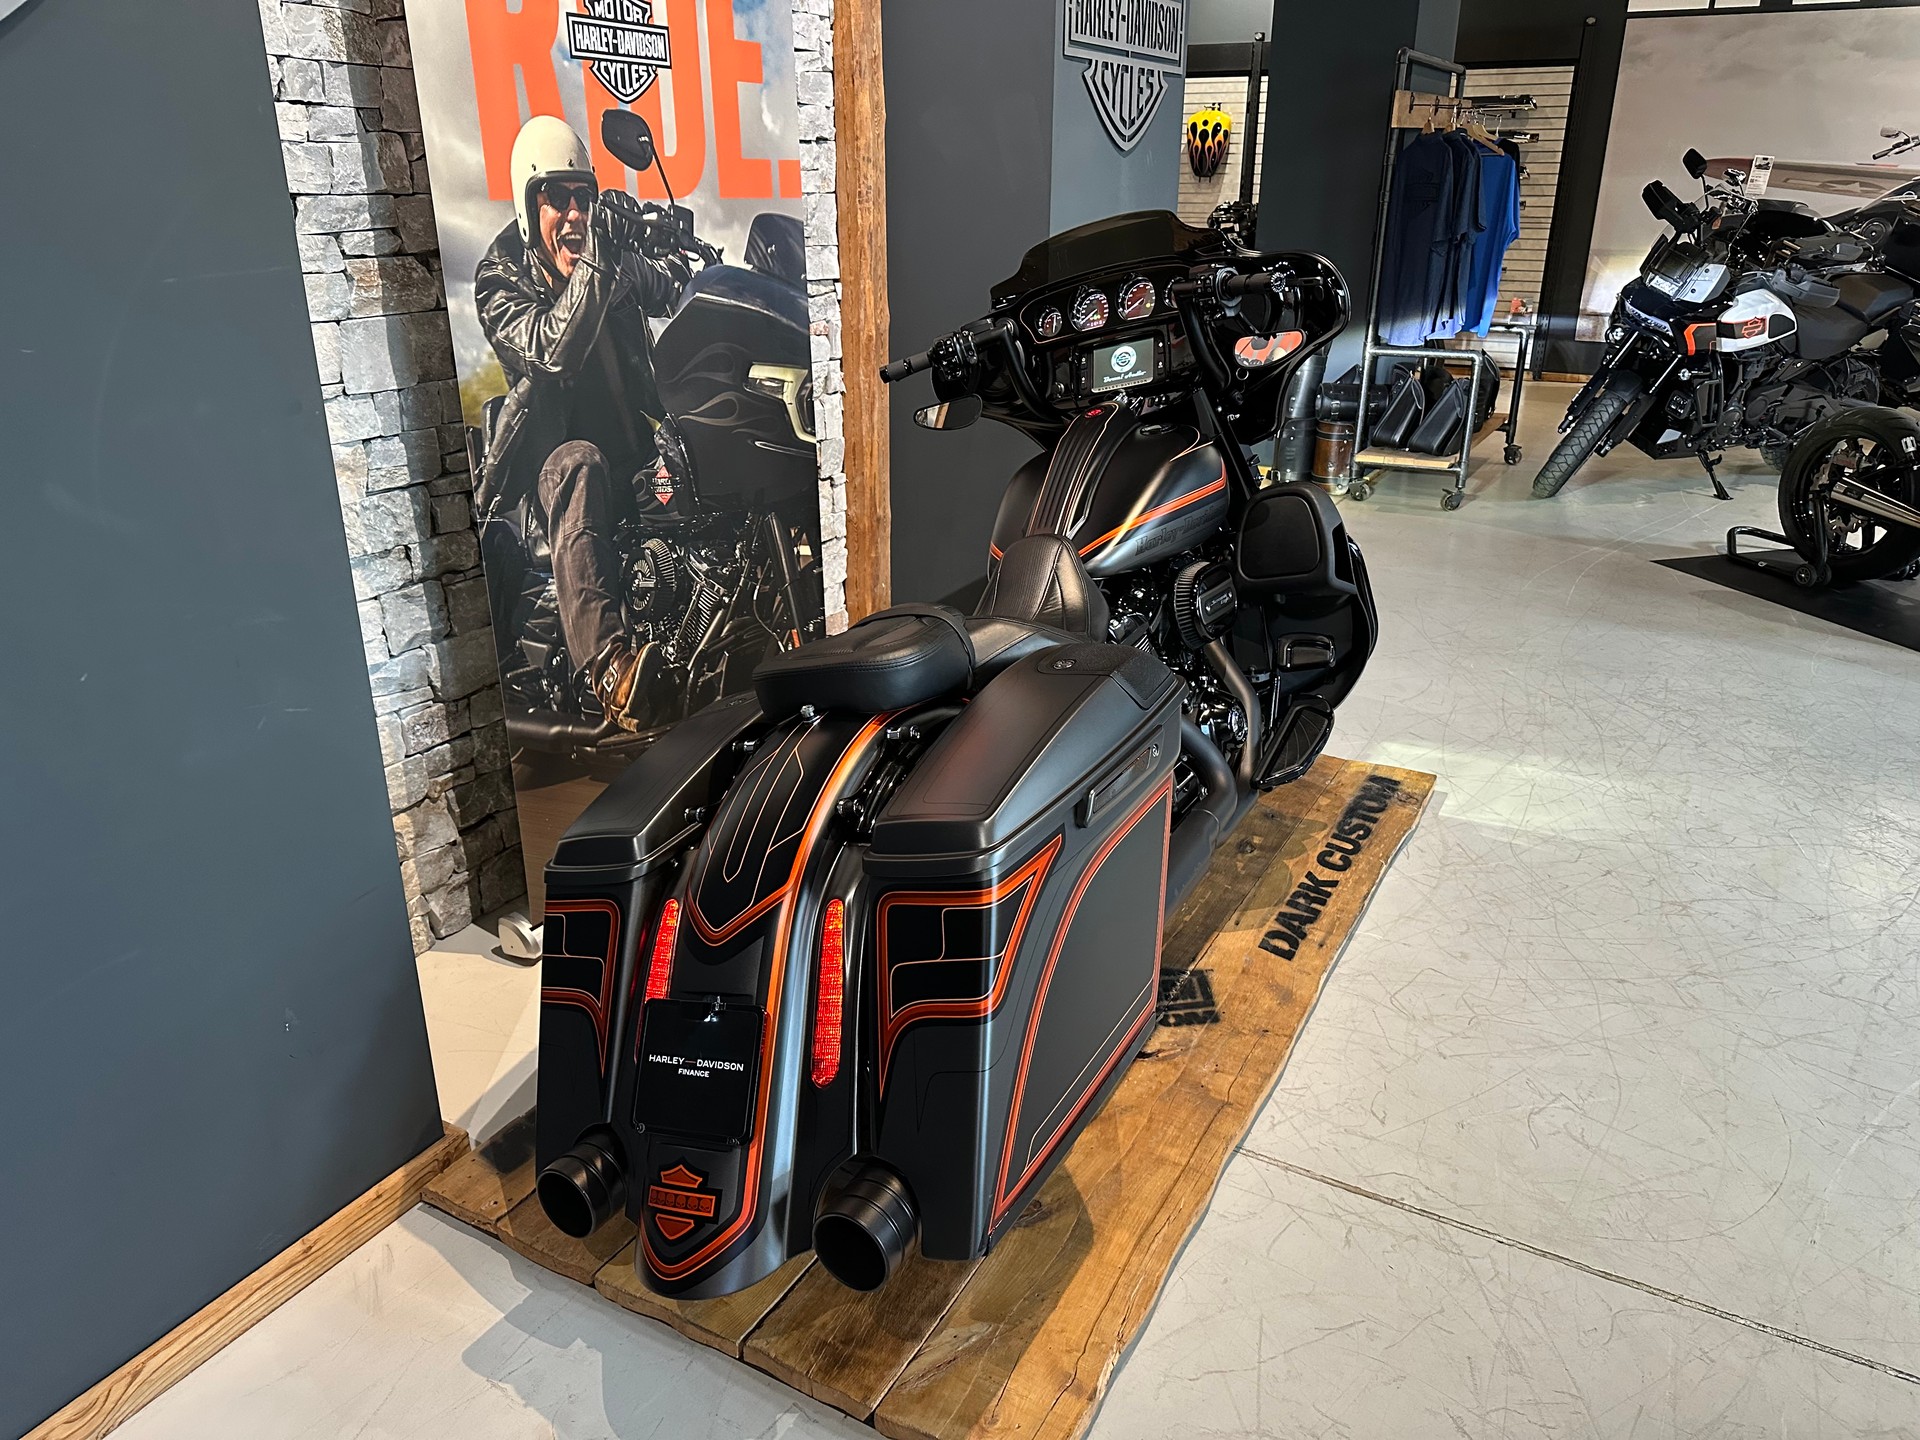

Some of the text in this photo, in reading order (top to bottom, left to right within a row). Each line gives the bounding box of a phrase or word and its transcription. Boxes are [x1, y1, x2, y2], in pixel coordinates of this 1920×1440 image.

[594, 0, 643, 24] MOTOR
[1074, 0, 1179, 54] HARLEY-DAVIDSON
[574, 24, 666, 60] HARLEY-DAVIDSON
[600, 61, 648, 95] CYCLES
[1101, 61, 1155, 131] CYCLES
[1135, 504, 1224, 556] Harley-David
[1258, 774, 1401, 962] DARK CUSTOM
[677, 1068, 710, 1078] FINANCE
